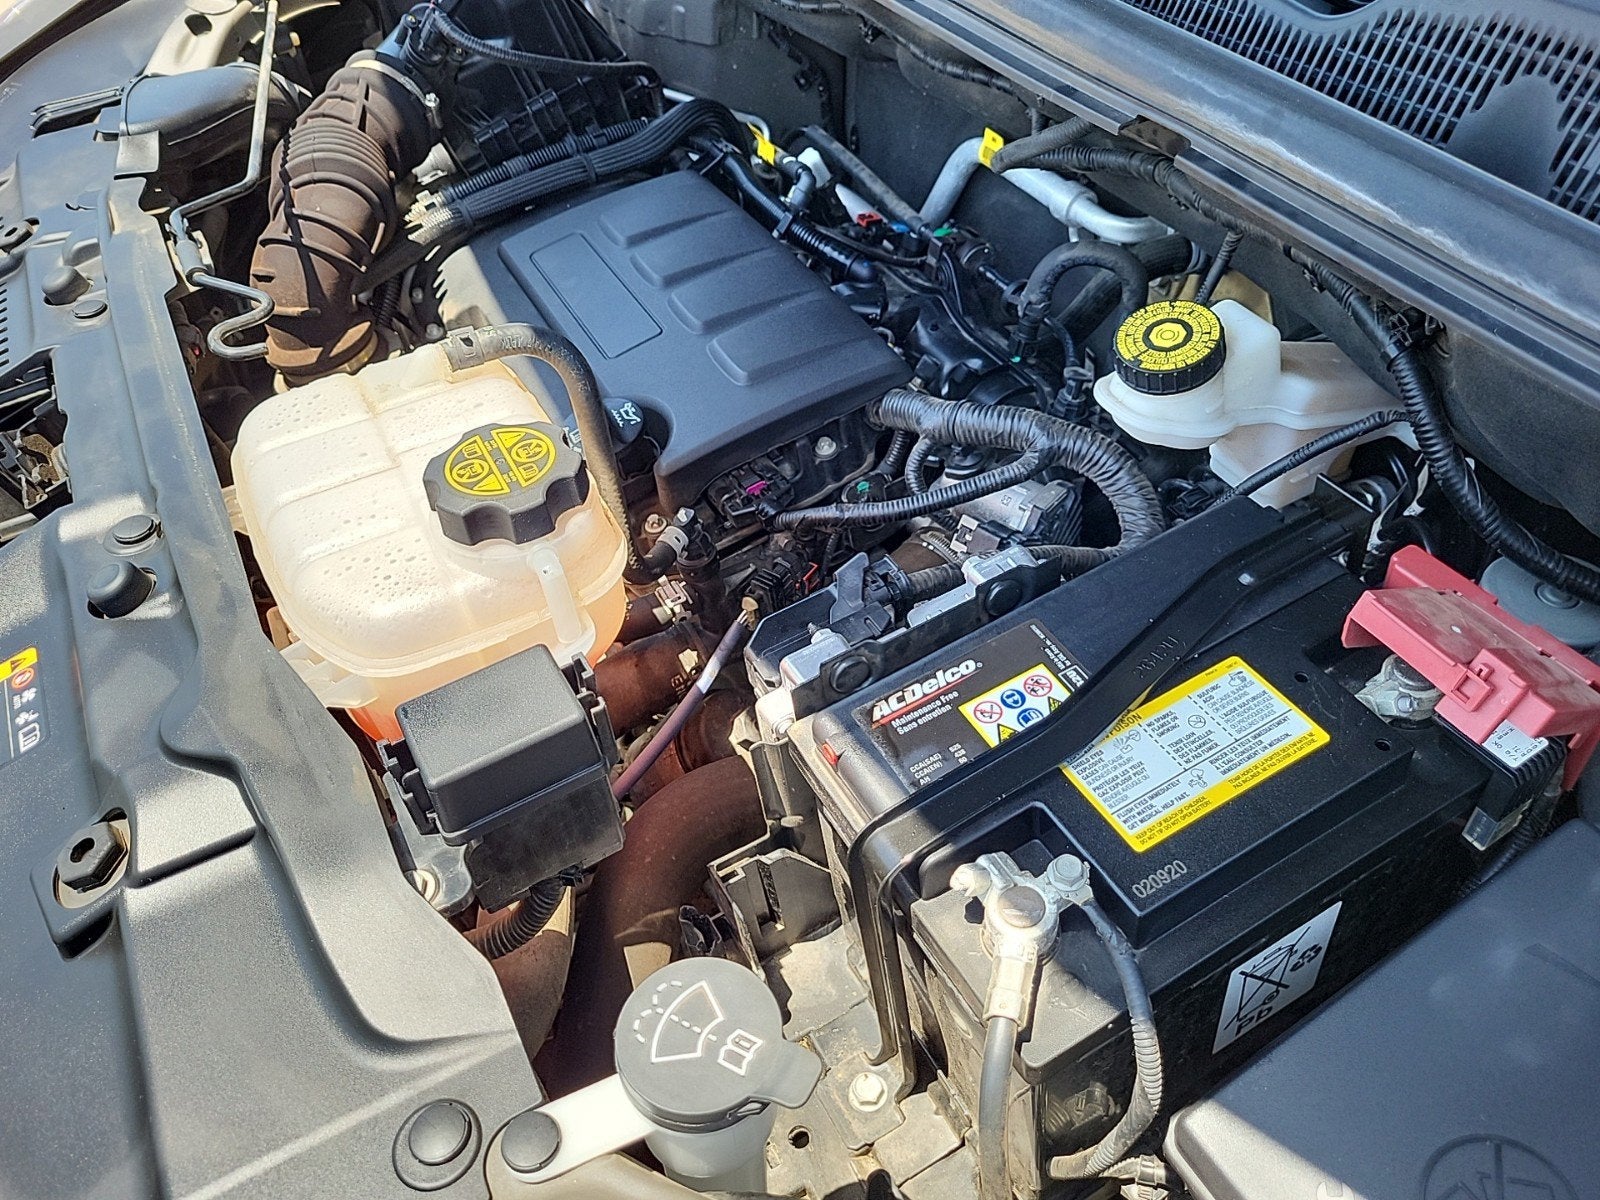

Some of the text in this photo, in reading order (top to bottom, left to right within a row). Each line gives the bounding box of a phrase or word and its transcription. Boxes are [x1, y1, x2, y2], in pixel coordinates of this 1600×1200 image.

[872, 659, 977, 723] ACDelco
[891, 689, 959, 728] Maintenance Free
[896, 703, 952, 735] Sans entretien
[1152, 720, 1171, 733] FLAMES
[1157, 722, 1179, 738] SMOKING
[1192, 752, 1202, 760] PAS
[1227, 746, 1238, 754] LES
[1237, 738, 1252, 748] YEUX
[1234, 739, 1264, 758] CONSULTER
[909, 752, 943, 774] CCA(SAE)
[913, 760, 944, 779] CCA(EN)
[1072, 757, 1090, 770] SHIELD
[1090, 749, 1103, 760] EYES
[1077, 757, 1104, 776] EXPLOSIVE
[1129, 760, 1144, 771] YEUX
[1082, 768, 1098, 780] GASES
[1098, 767, 1147, 798] GAZ EXPLOSIF PEUT
[1117, 779, 1181, 819] FLUSH EYES IMMEDIATELY
[1123, 814, 1136, 824] WITH
[1128, 821, 1139, 830] GET
[1139, 808, 1162, 824] MEDICAL
[1162, 800, 1175, 810] HELP
[1131, 859, 1188, 899] 020920
[1235, 1005, 1274, 1037] Pb
